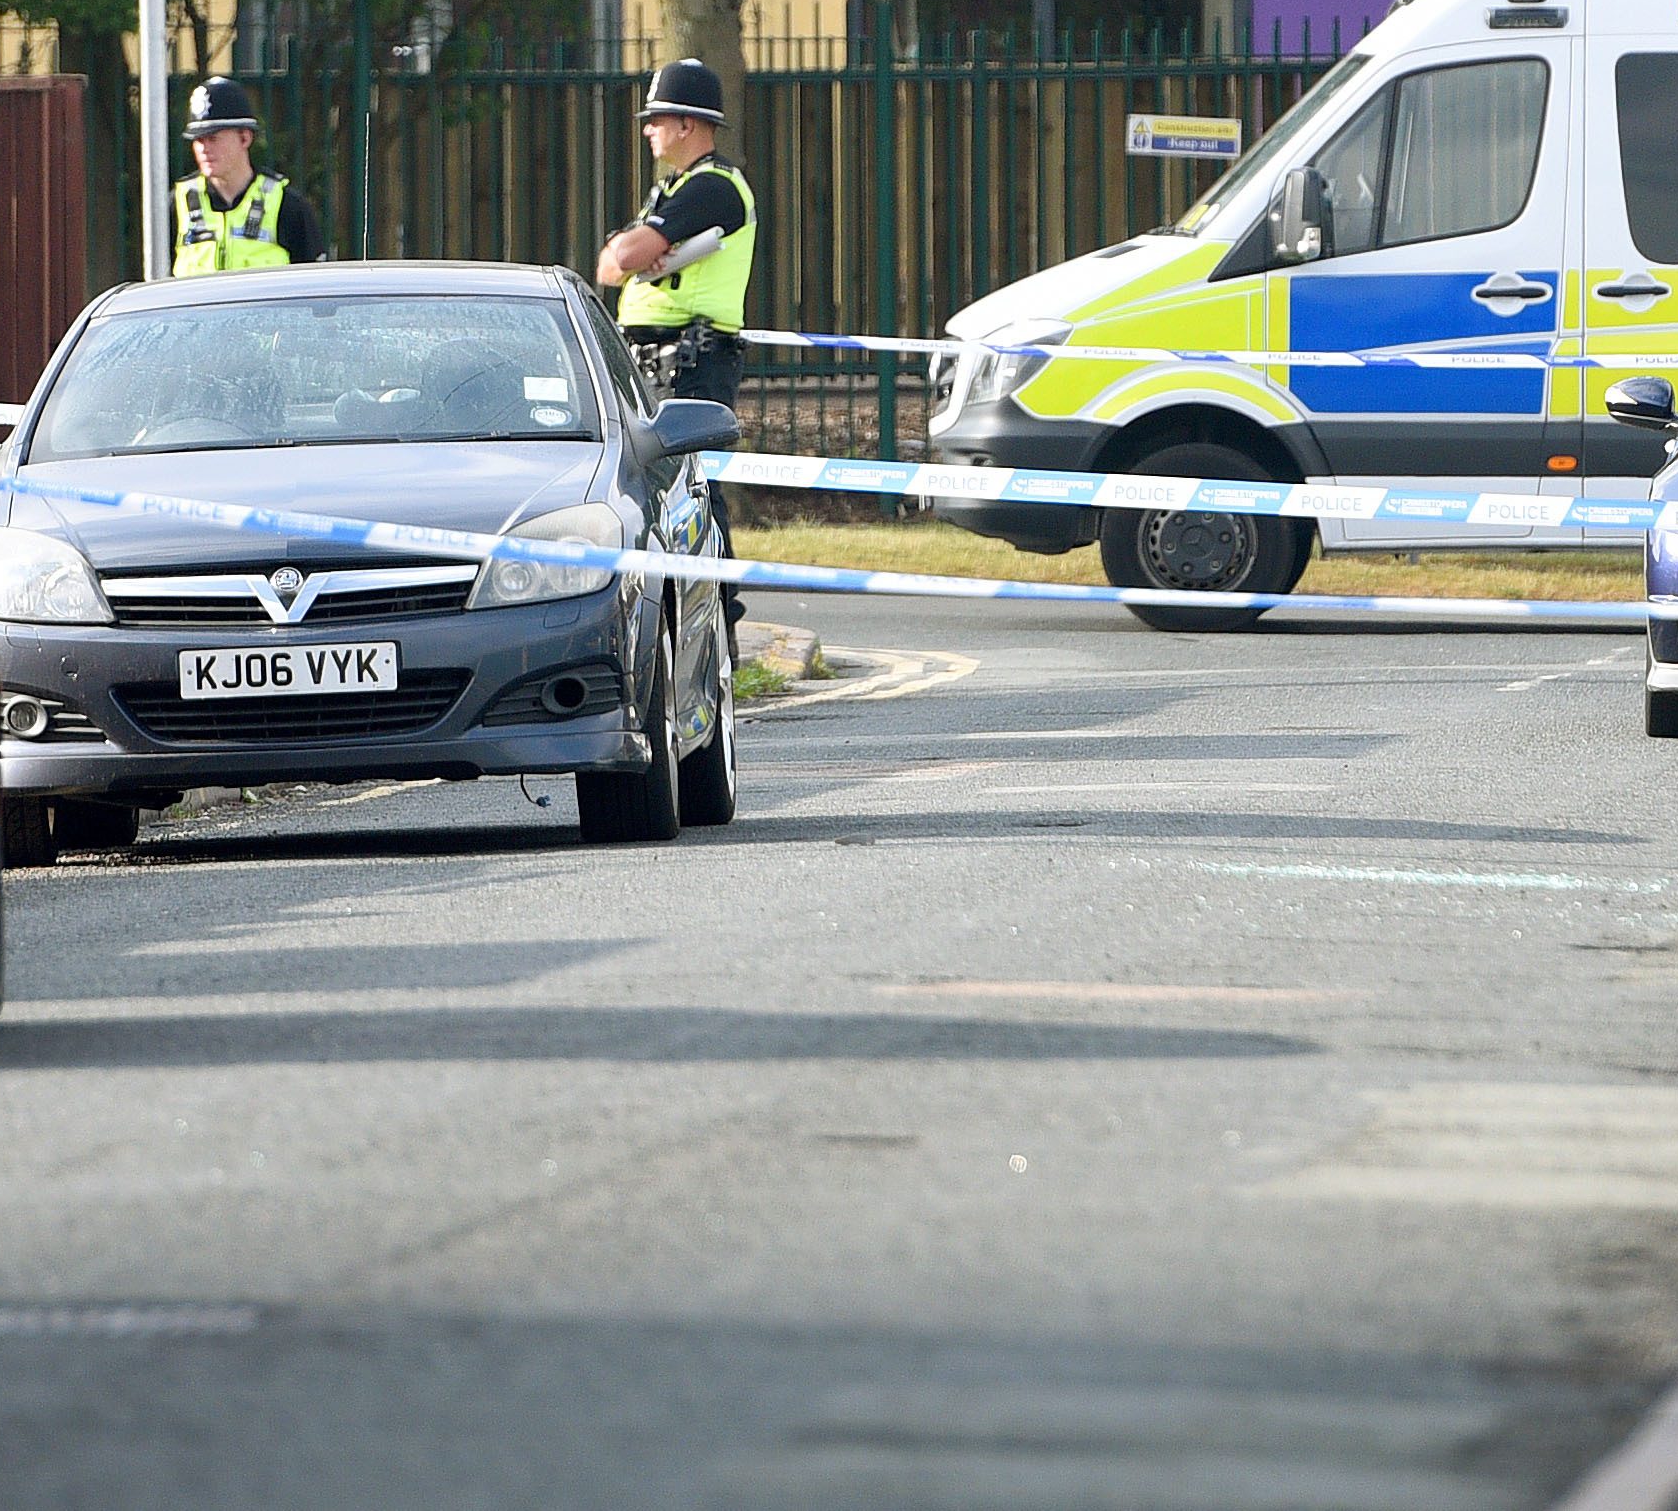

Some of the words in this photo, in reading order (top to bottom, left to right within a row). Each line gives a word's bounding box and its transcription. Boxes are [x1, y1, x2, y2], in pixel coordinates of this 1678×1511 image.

[741, 463, 803, 480] POLICE
[928, 474, 988, 491] POLICE
[1114, 485, 1176, 502] POLICE
[143, 496, 225, 520] POLICE
[1301, 495, 1362, 511] POLICE
[1488, 504, 1550, 520] POLICE
[195, 652, 293, 690] KJ06
[306, 648, 379, 685] VYK
